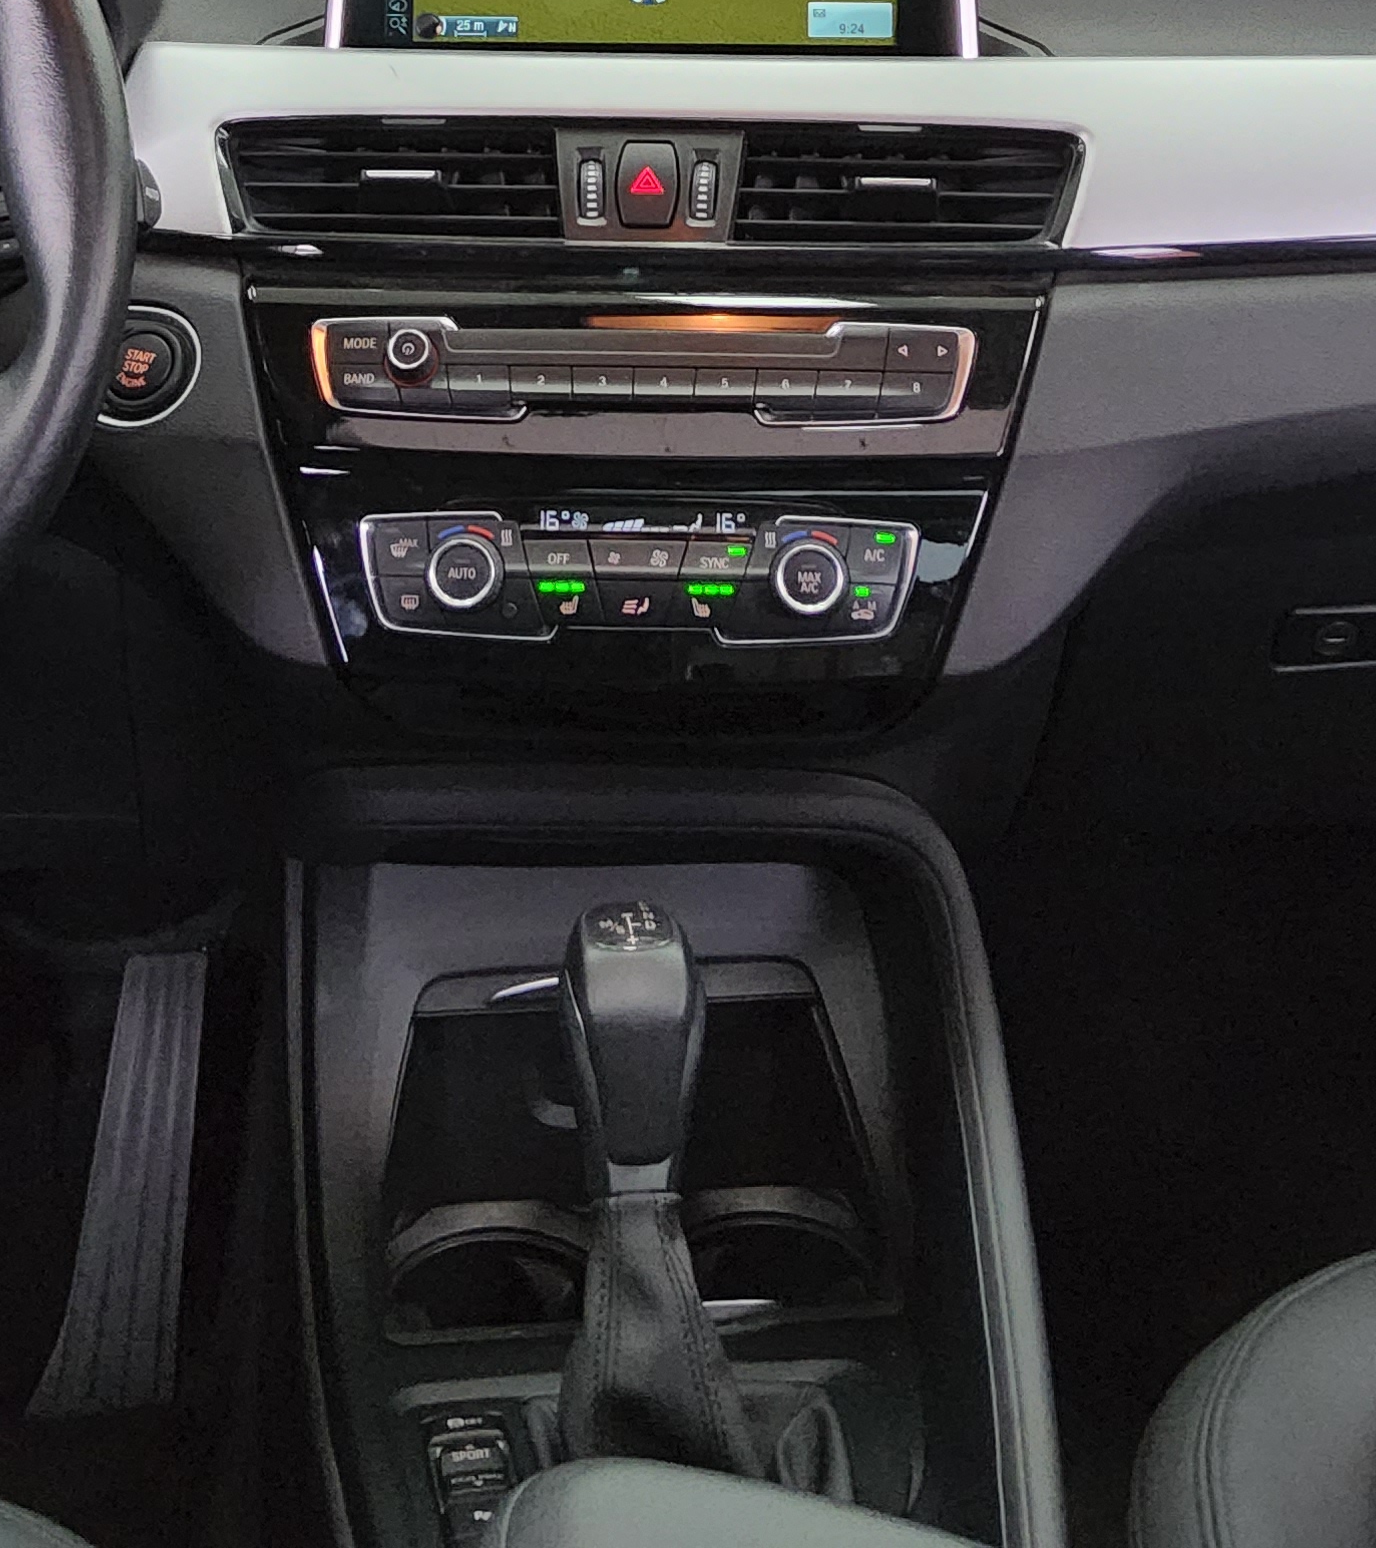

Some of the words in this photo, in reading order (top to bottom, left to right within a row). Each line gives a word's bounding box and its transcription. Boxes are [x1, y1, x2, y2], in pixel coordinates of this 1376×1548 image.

[456, 20, 471, 31] 25
[473, 21, 484, 31] m
[839, 23, 865, 34] 9:24
[342, 337, 377, 350] MODE
[125, 348, 157, 364] START
[122, 361, 150, 374] STOP
[343, 372, 375, 385] BAND
[476, 374, 483, 384] 1
[536, 374, 546, 385] 2
[598, 376, 607, 387] 3
[659, 377, 668, 388] 4
[721, 377, 729, 388] 5
[781, 379, 790, 389] 6
[844, 379, 852, 390] 7
[912, 382, 921, 393] 8
[399, 538, 419, 548] MAX
[547, 553, 570, 565] OFF
[863, 548, 885, 562] A/C
[700, 556, 729, 569] SYNC
[447, 567, 476, 580] AUTO
[797, 571, 822, 583] MAX
[800, 582, 819, 594] A/C
[644, 920, 657, 930] D
[451, 1448, 491, 1463] SPORT
